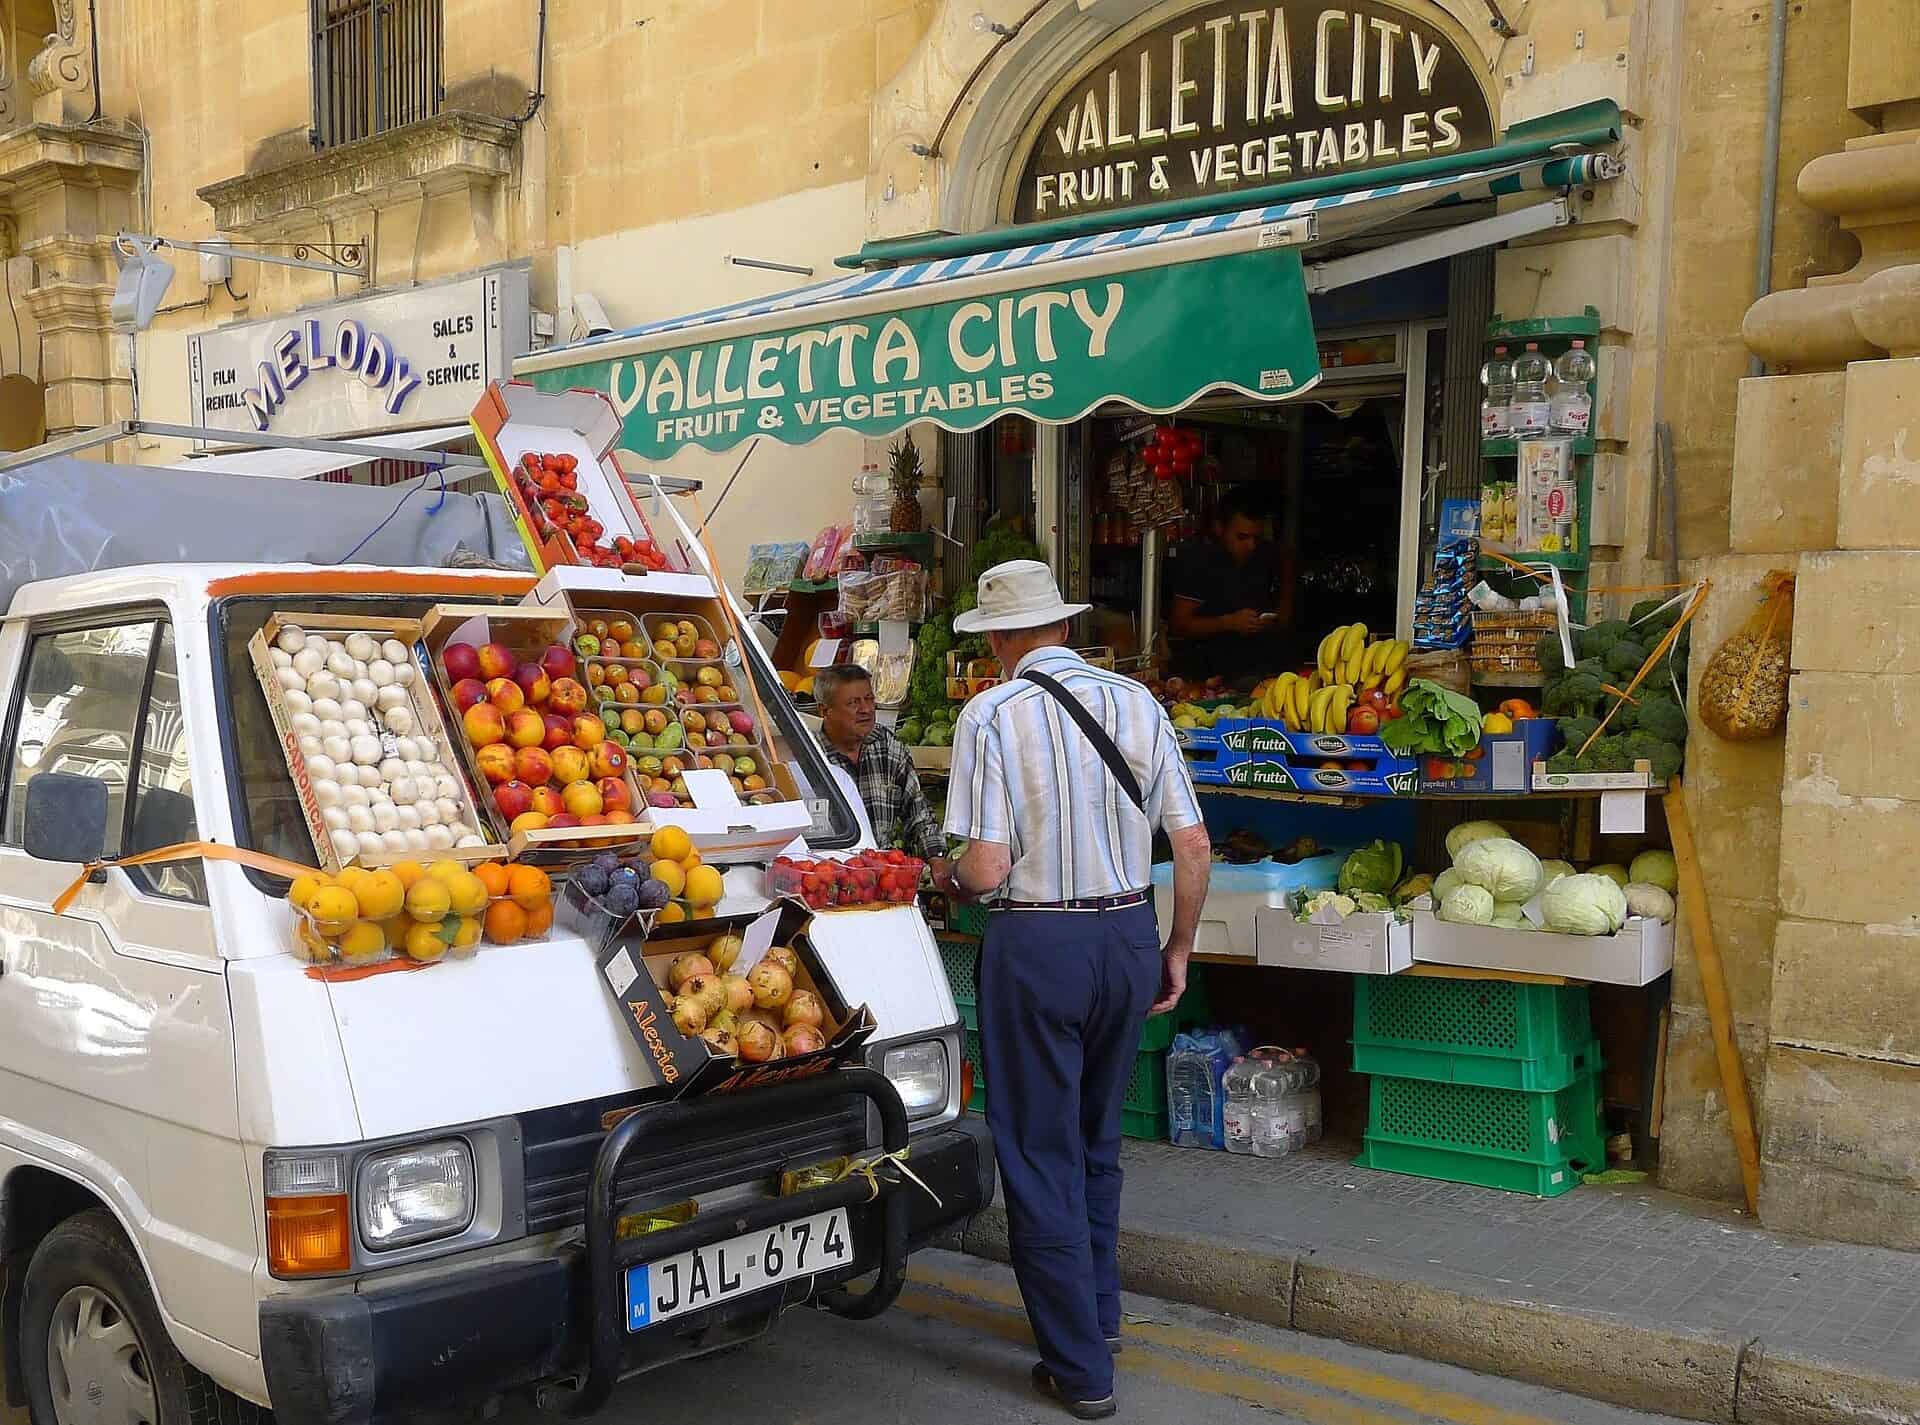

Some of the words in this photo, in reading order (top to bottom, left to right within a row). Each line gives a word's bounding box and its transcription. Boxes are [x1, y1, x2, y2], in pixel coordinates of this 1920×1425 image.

[1056, 7, 1295, 155] VALLETTA
[1315, 9, 1441, 112] CITY
[1036, 159, 1138, 213] FRUIT
[1149, 155, 1170, 192] &
[1190, 105, 1463, 188] VEGETABLES
[489, 280, 498, 329] TEL
[433, 315, 474, 338] SALES
[448, 343, 457, 359] &
[609, 317, 921, 417] VALLETTA
[948, 283, 1124, 373] CITY
[213, 368, 236, 387] FILM
[241, 318, 422, 431] MELODY
[427, 363, 480, 386] SERVICE
[205, 390, 247, 411] RENTALS
[656, 408, 745, 443] FRUIT
[757, 405, 785, 430] &
[794, 372, 1055, 425] VEGETABLES
[1228, 734, 1245, 748] Val
[1252, 738, 1286, 750] frutta
[1231, 768, 1248, 782] Val
[1254, 770, 1287, 784] frutta
[1393, 776, 1412, 791] Val
[628, 1001, 679, 1084] Alexia
[634, 1302, 645, 1318] M
